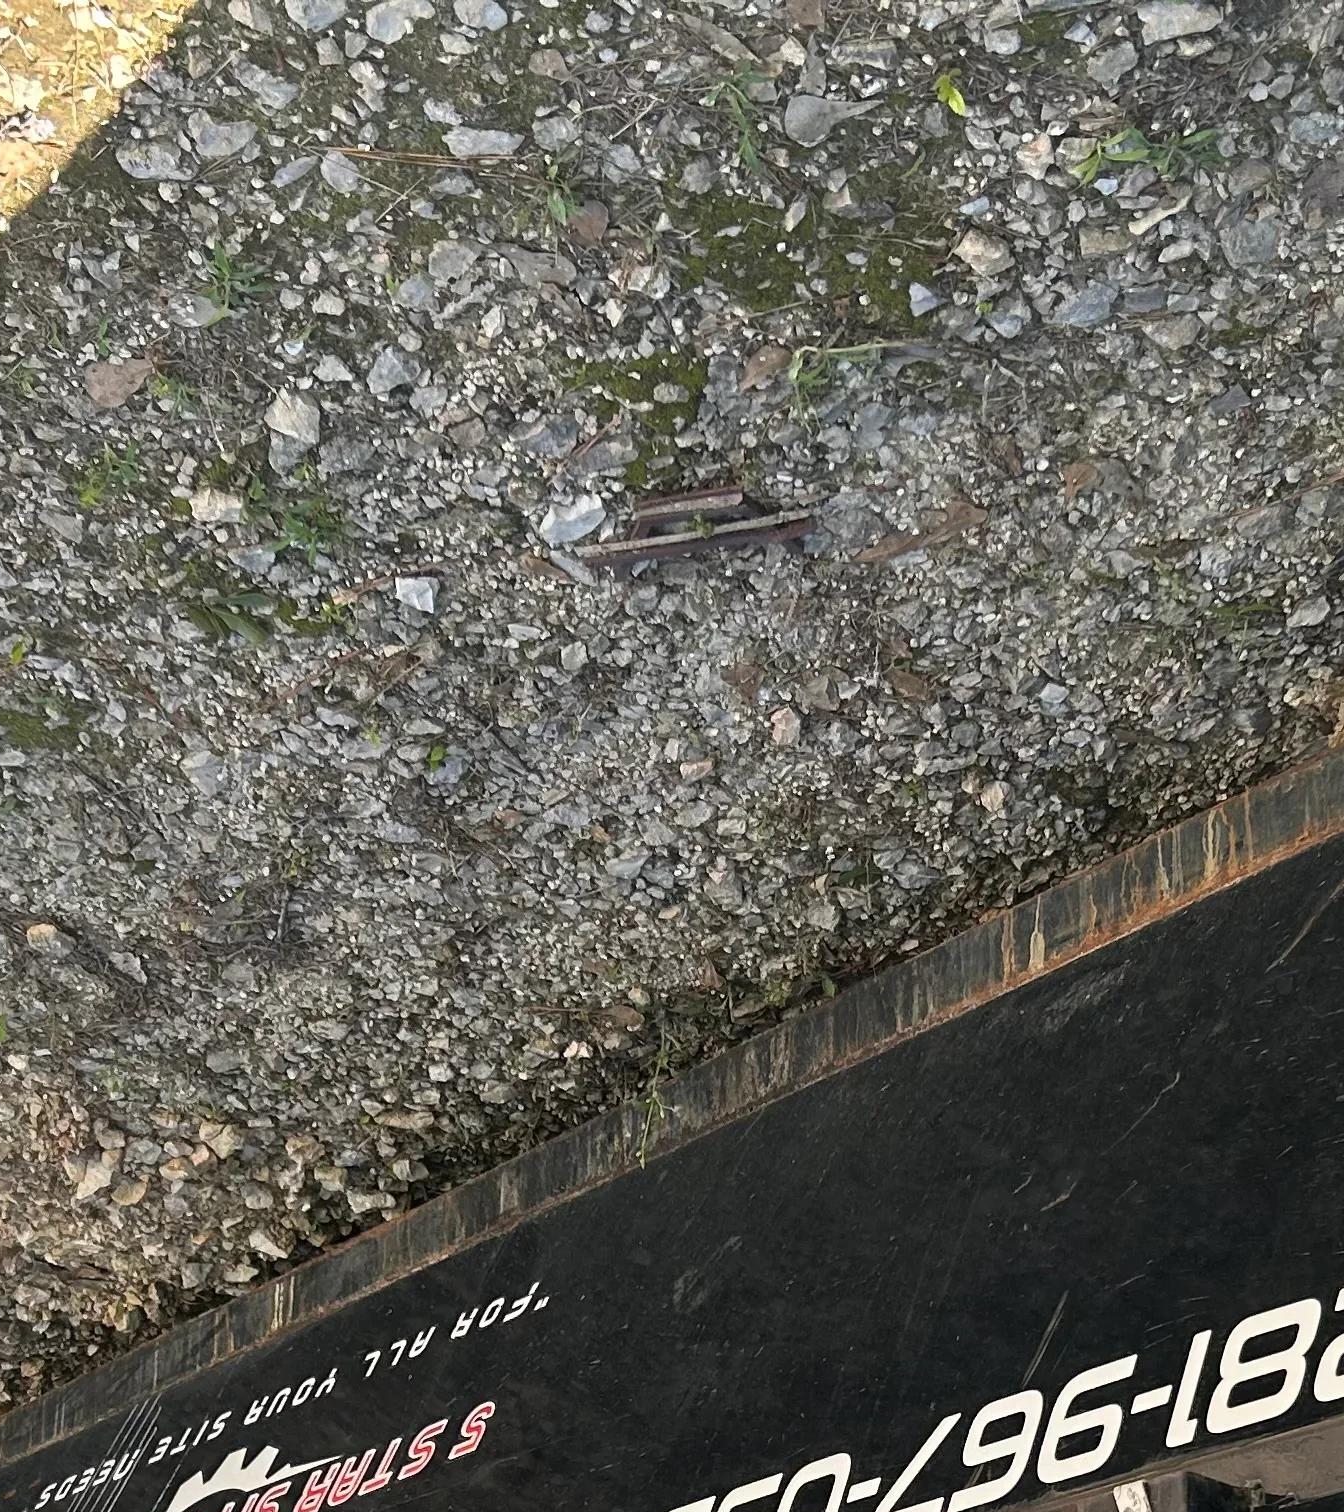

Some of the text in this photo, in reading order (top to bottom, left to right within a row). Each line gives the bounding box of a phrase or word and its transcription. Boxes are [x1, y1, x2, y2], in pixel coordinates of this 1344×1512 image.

[450, 1282, 550, 1340] "FOR
[363, 1325, 437, 1378] ALL
[243, 1368, 337, 1426] YOUR
[148, 1411, 232, 1466] SITE
[448, 1401, 497, 1460] 5
